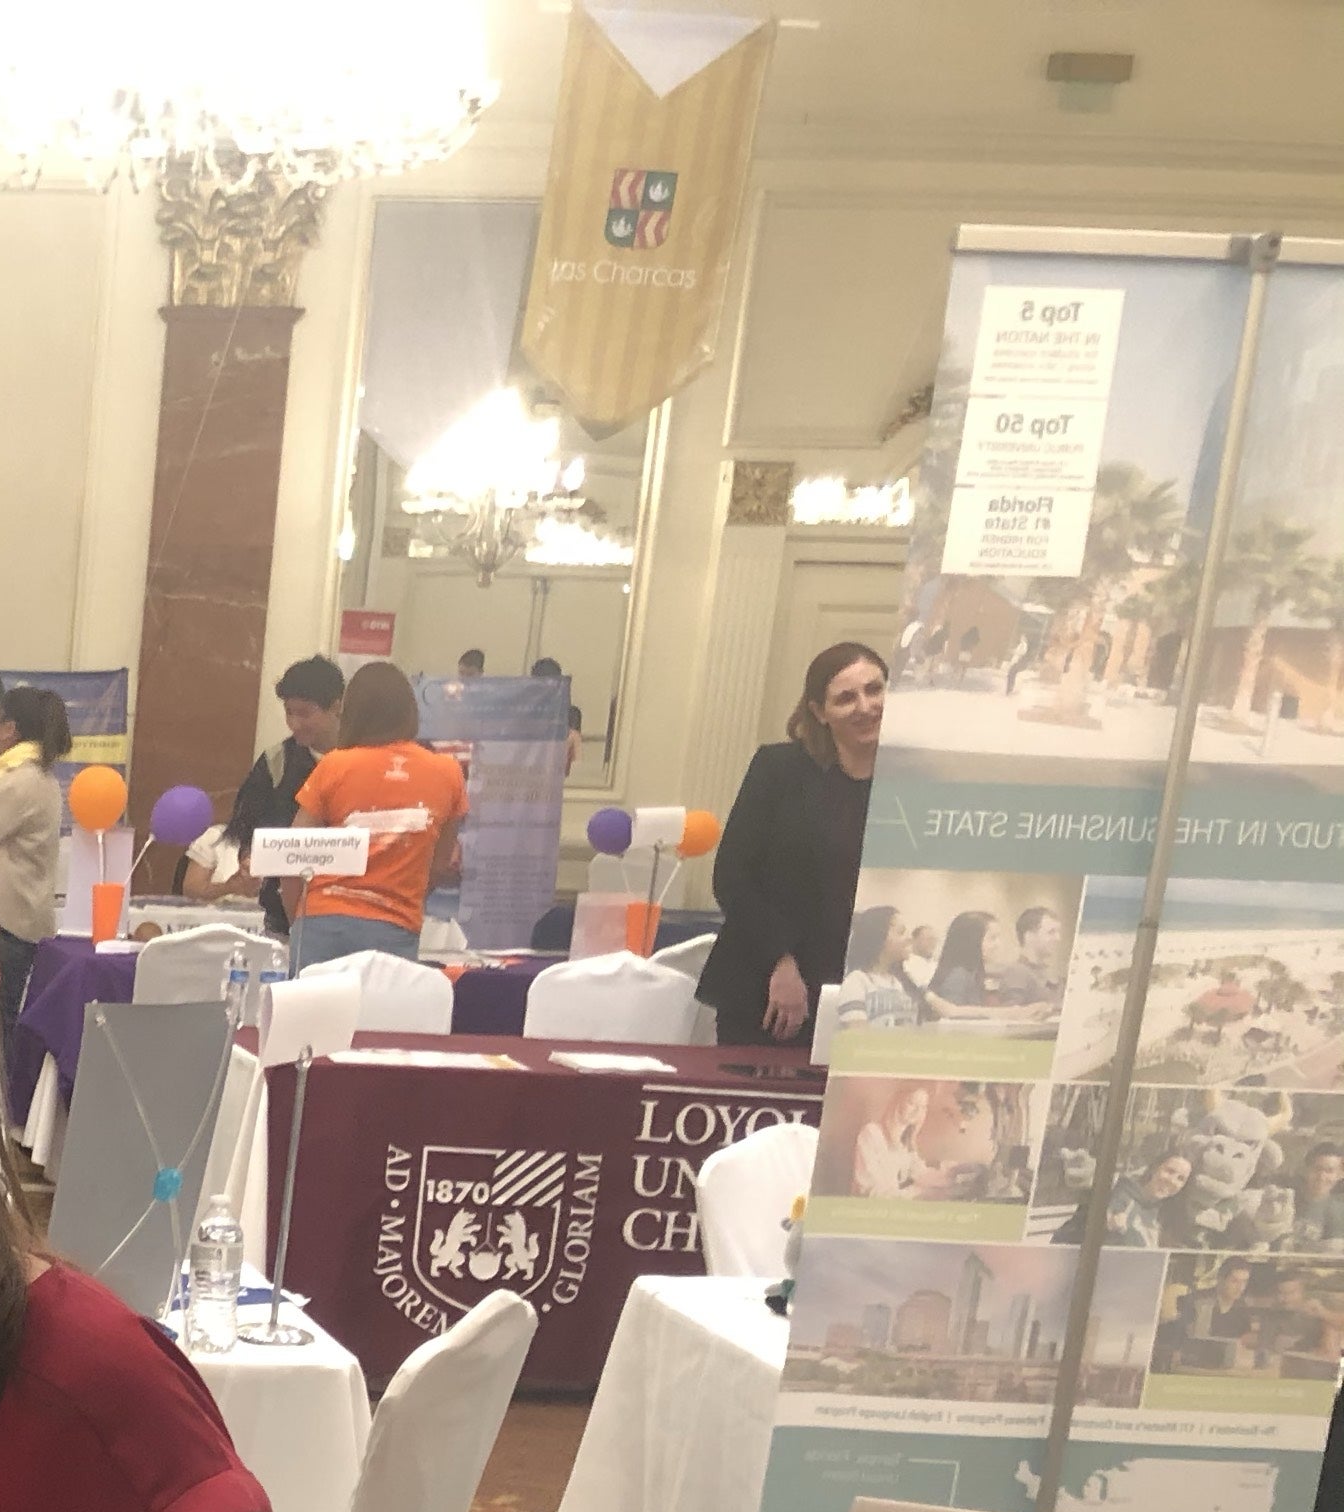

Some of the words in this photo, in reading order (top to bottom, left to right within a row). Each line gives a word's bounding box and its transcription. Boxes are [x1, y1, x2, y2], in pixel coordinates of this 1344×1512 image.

[593, 259, 696, 288] Charcas
[262, 837, 300, 851] Loyola
[304, 836, 361, 850] University
[286, 853, 334, 866] Chicago
[385, 1143, 412, 1192] AD
[426, 1179, 490, 1205] 1870
[552, 1153, 603, 1304] GLORIAM
